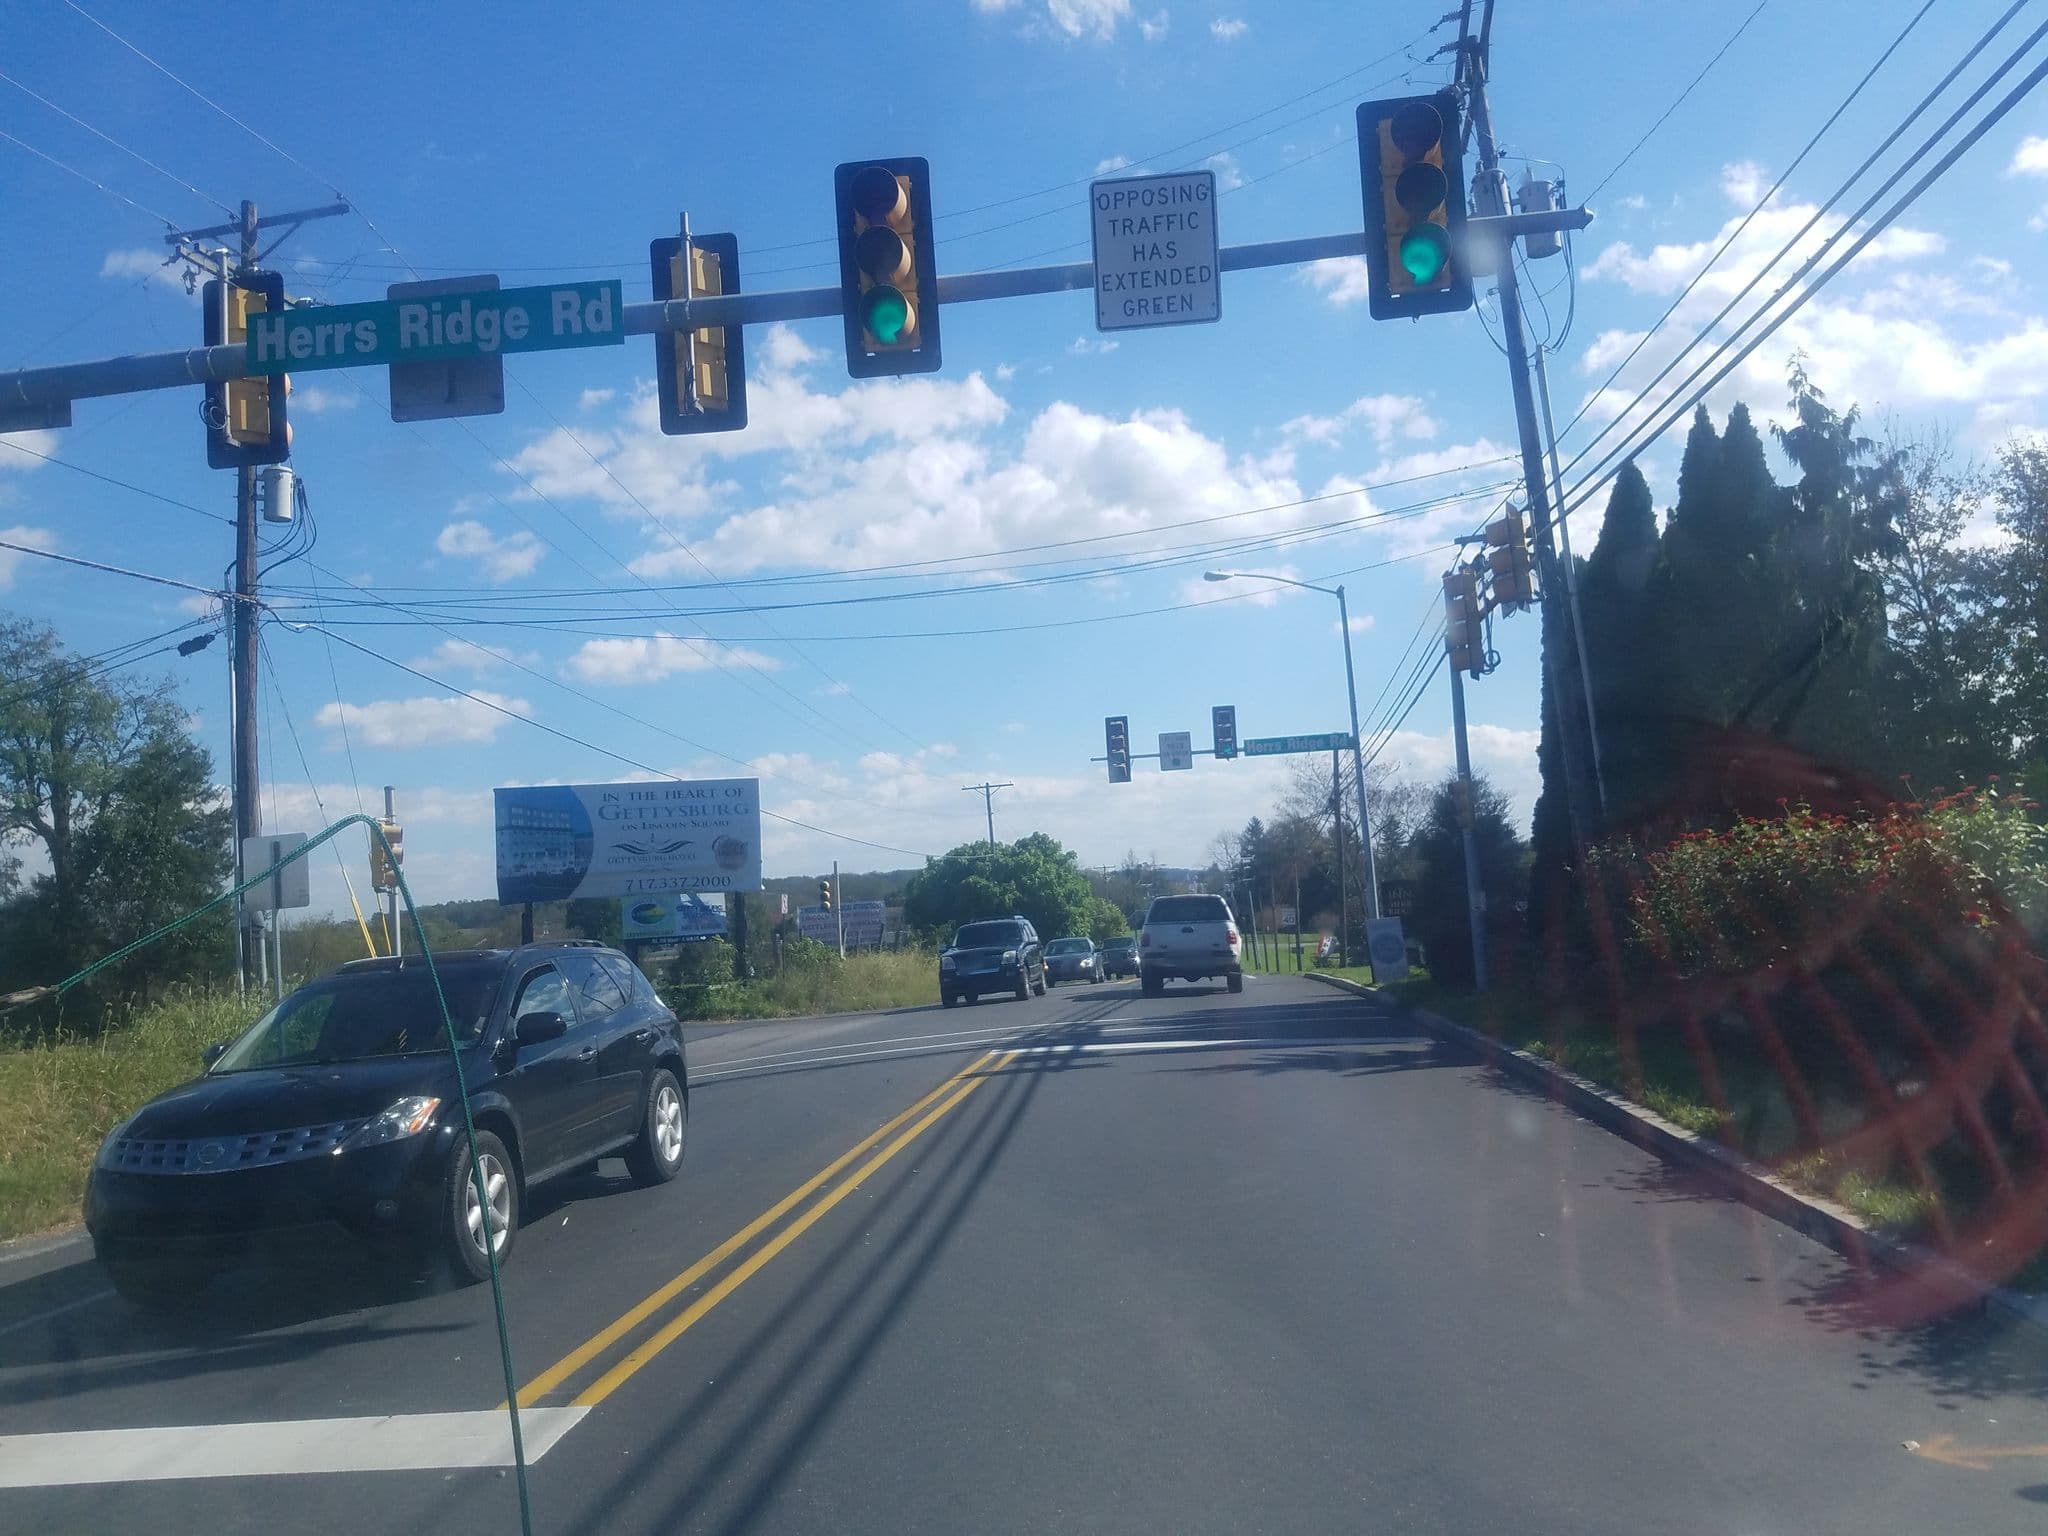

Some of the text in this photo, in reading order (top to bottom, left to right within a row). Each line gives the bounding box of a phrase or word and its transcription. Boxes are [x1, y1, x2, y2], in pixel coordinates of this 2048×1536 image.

[1098, 184, 1209, 211] OPPOSING
[1108, 211, 1199, 237] TRAFFIC
[1133, 241, 1177, 262] HAS
[1102, 265, 1211, 292] EXTENDED
[1123, 294, 1193, 317] GREEN
[257, 287, 613, 362] Herrs Ridge Rd
[1249, 734, 1348, 753] Herrs Ridge Rd
[602, 786, 744, 802] IN THE HEART OF
